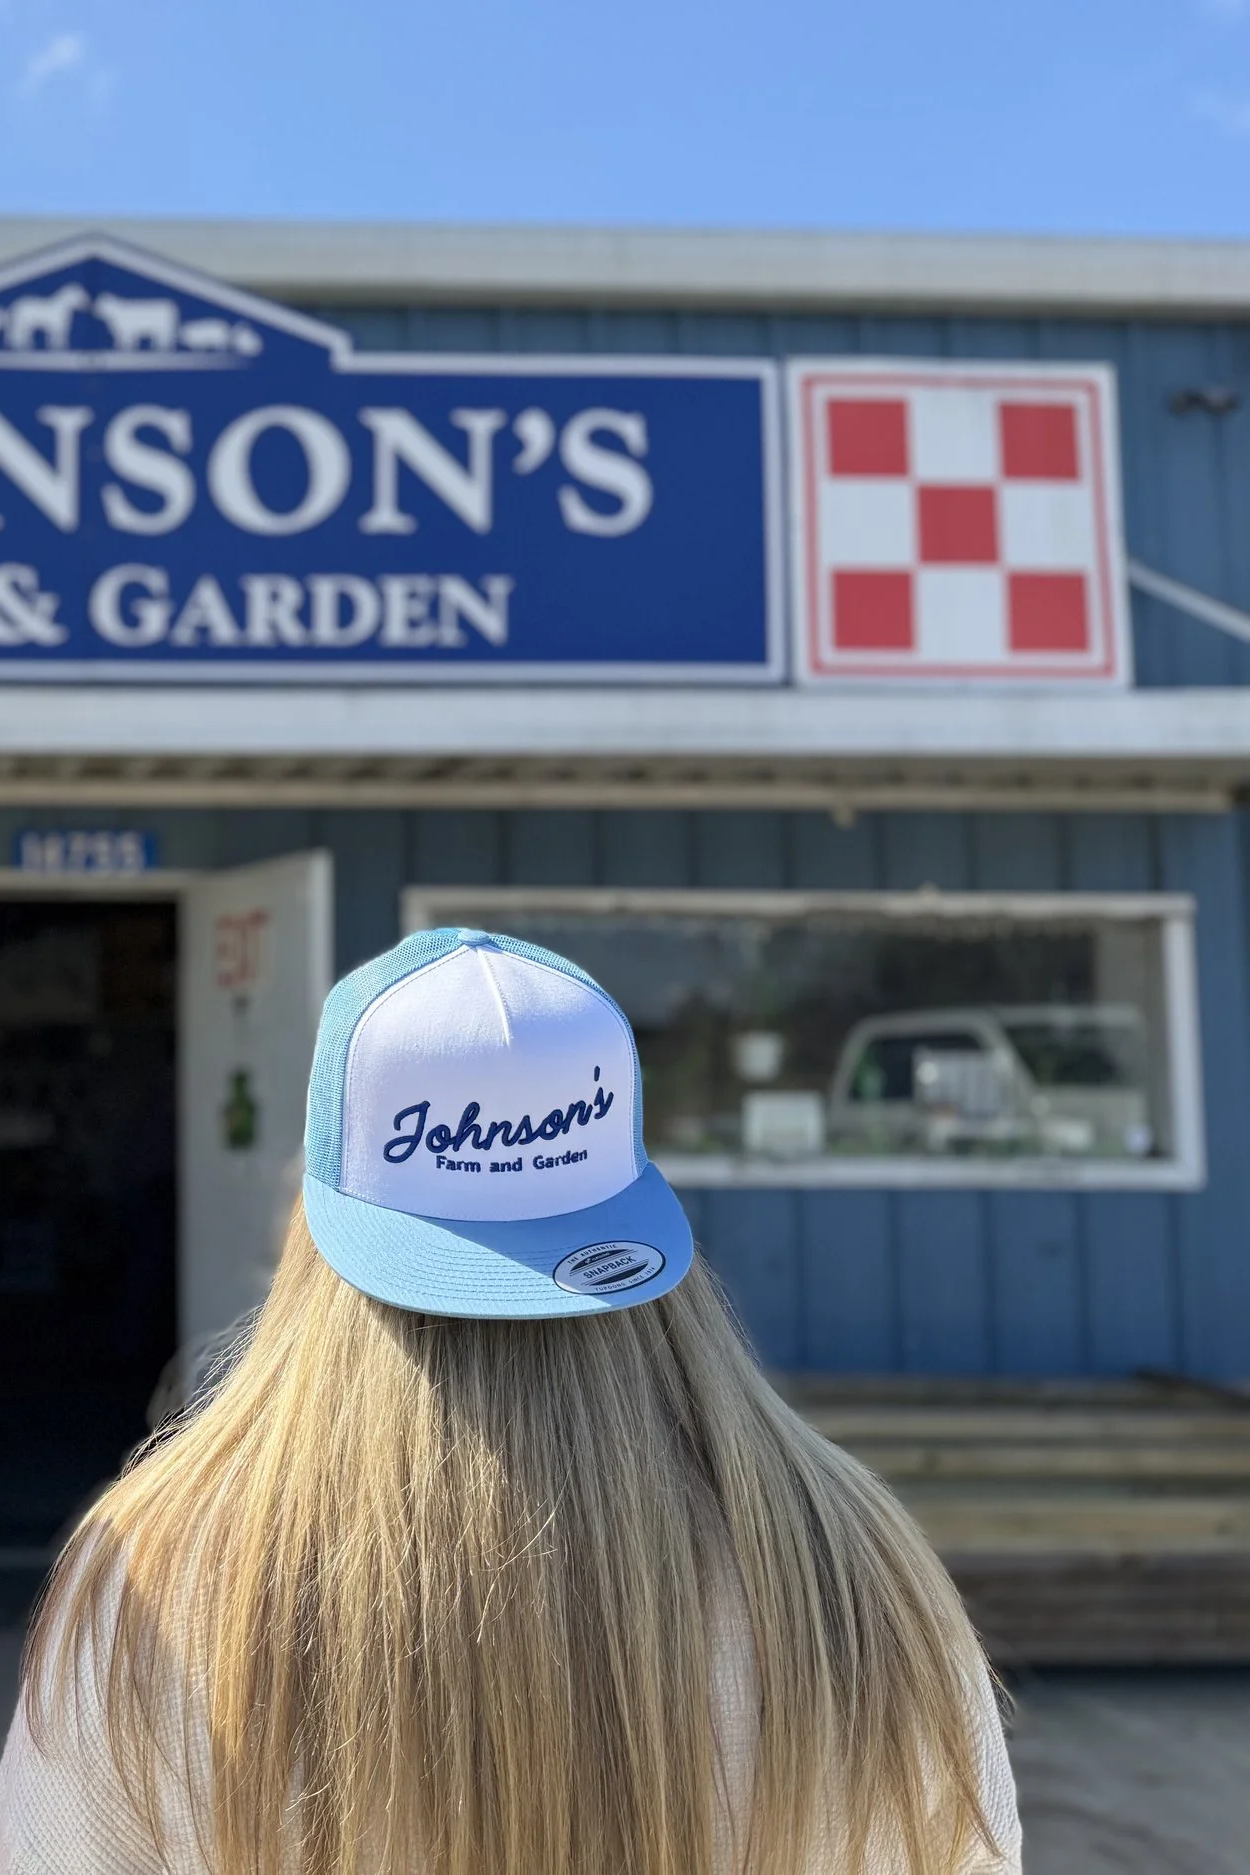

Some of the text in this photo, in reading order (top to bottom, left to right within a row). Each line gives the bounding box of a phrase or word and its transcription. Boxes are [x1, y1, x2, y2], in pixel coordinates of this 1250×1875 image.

[88, 562, 513, 648] GARDEN
[384, 1065, 614, 1164] Johnson's
[436, 1149, 587, 1173] Farm and Garden
[583, 1255, 637, 1279] SNAPBACK
